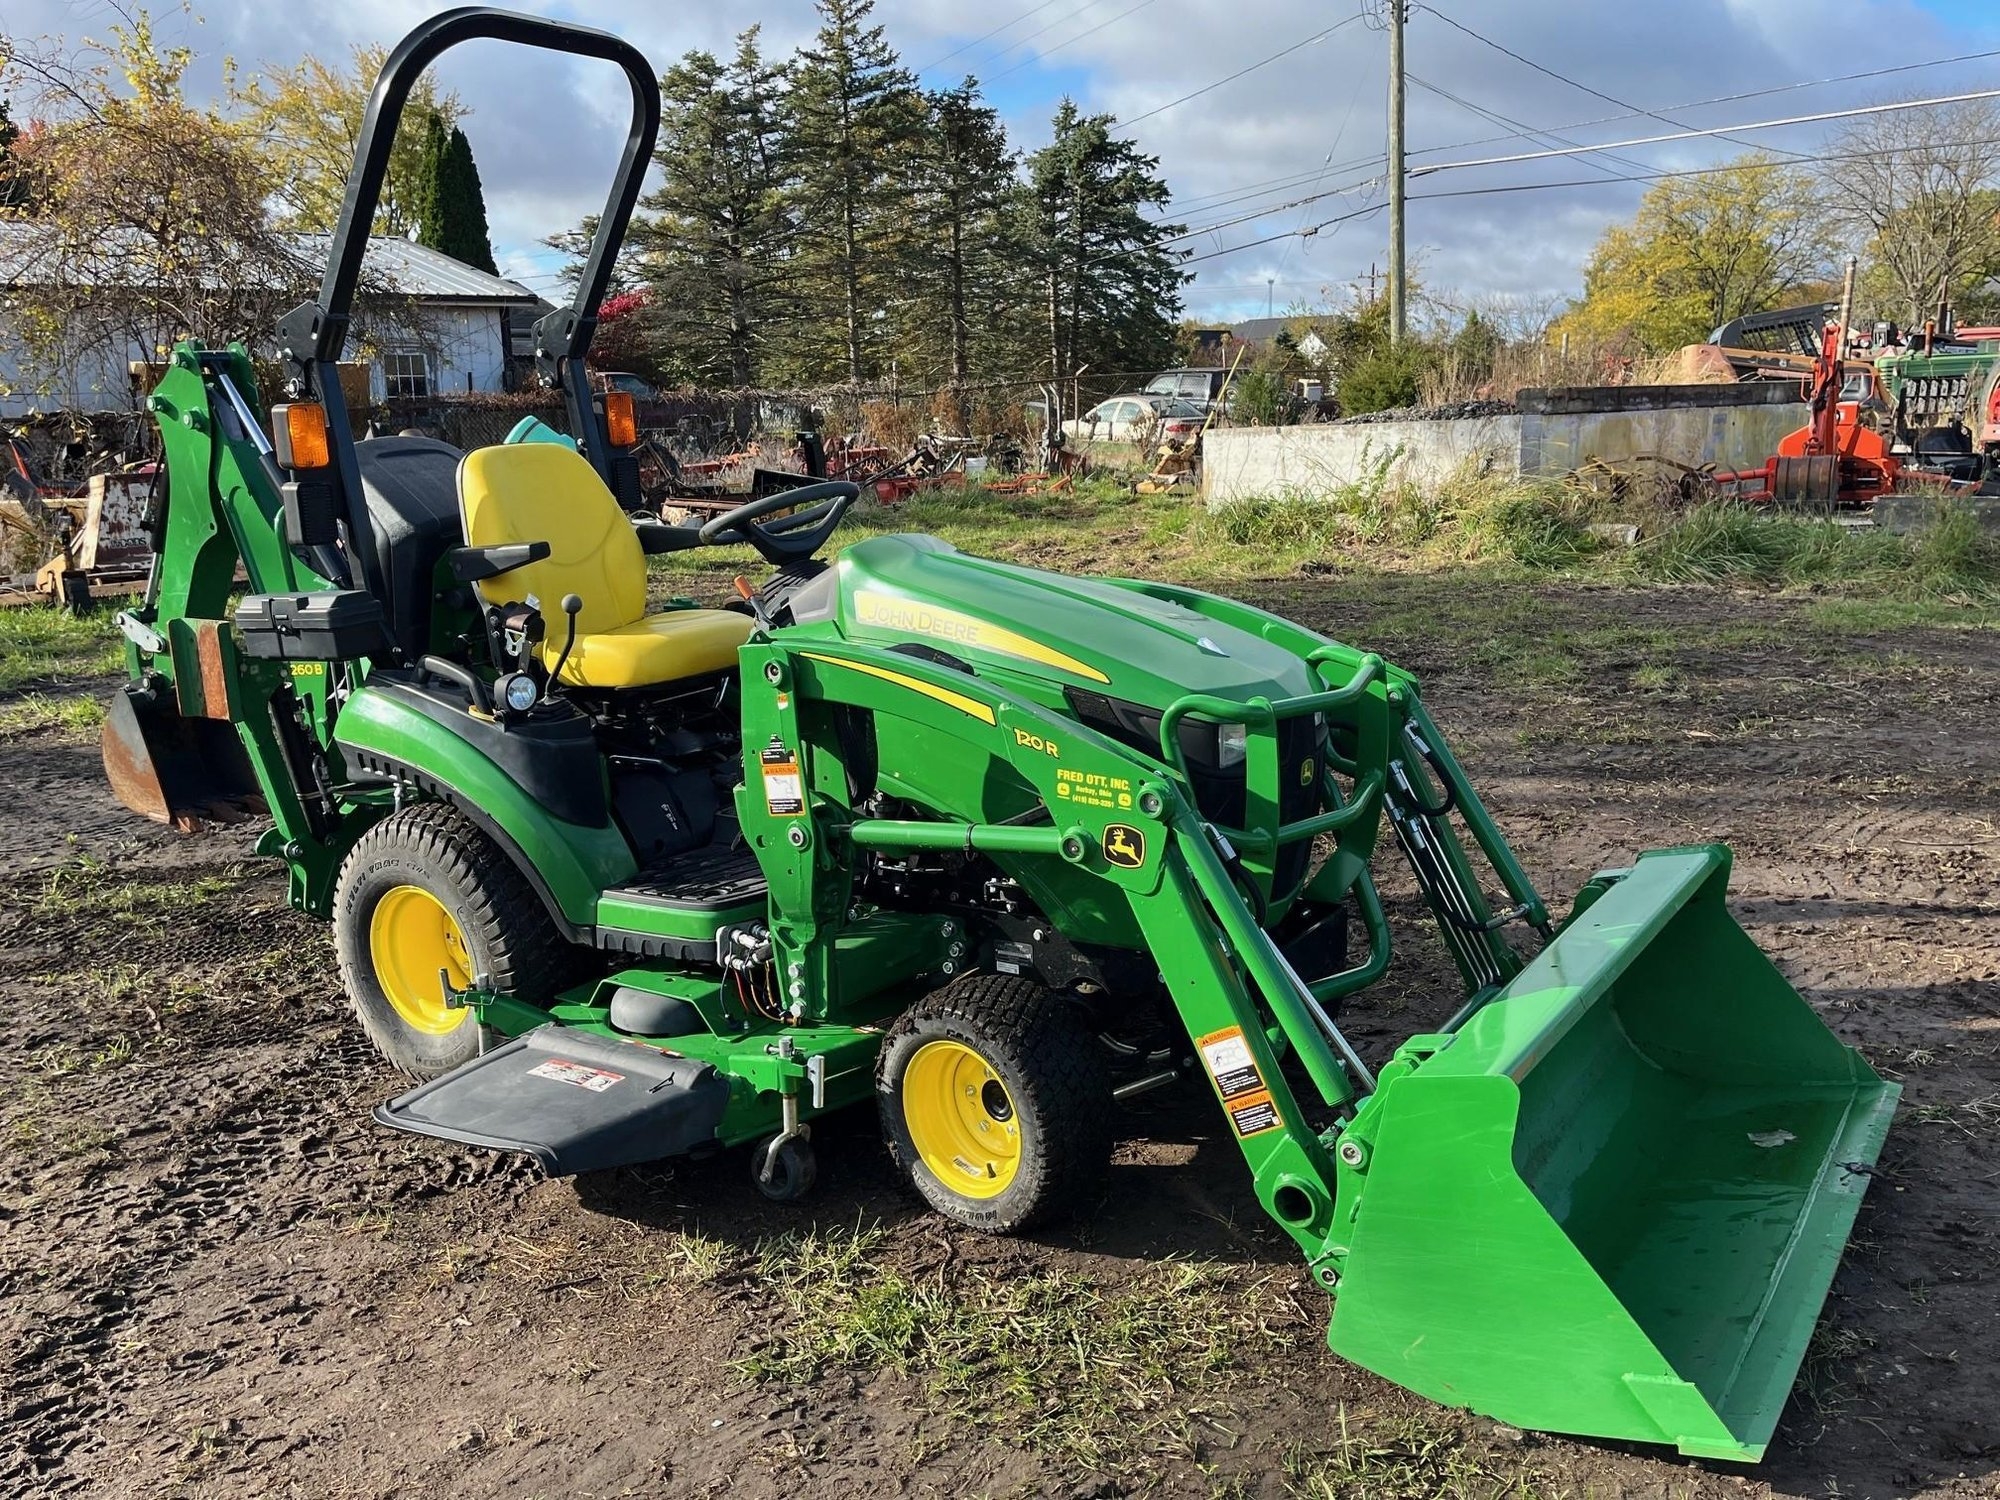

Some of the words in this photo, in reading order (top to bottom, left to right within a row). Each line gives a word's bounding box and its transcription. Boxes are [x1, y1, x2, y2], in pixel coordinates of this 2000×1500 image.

[868, 603, 914, 630] JOHN
[918, 612, 979, 642] DEERE
[1056, 769, 1083, 783] FRED
[1086, 774, 1108, 788] OTT,
[1110, 777, 1131, 791] INC.
[1098, 788, 1112, 797] Ohio
